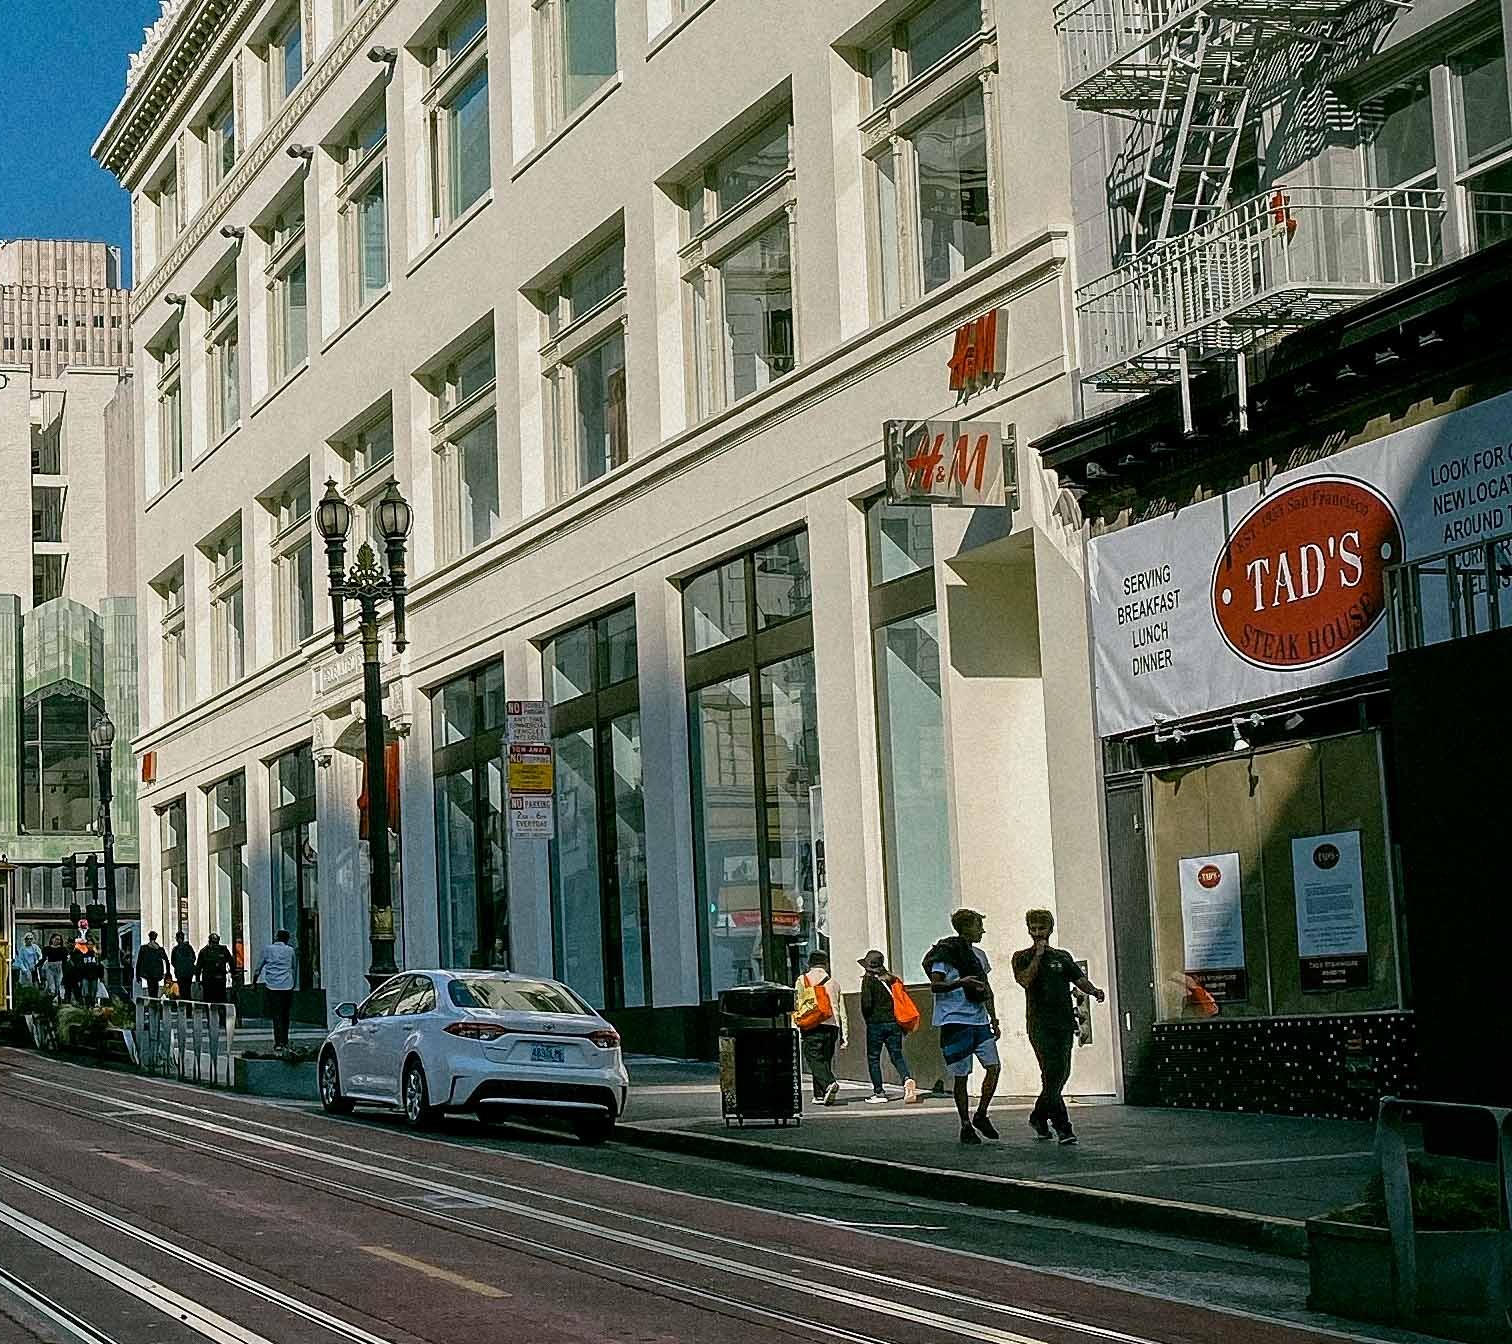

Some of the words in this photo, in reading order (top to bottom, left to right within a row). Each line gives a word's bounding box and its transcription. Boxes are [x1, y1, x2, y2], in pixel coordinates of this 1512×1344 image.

[906, 433, 988, 493] H&M
[1431, 456, 1470, 486] LOOK
[1473, 446, 1505, 473] FOR
[1433, 488, 1465, 516] NEW
[1443, 509, 1504, 544] AROUND
[1123, 564, 1171, 595] SERVING
[1246, 530, 1364, 612] TAD'S
[1118, 588, 1180, 626] BREAKFAST
[1132, 621, 1169, 649] LUNCH
[1239, 622, 1299, 660] STEAK
[1132, 649, 1173, 676] DINNER
